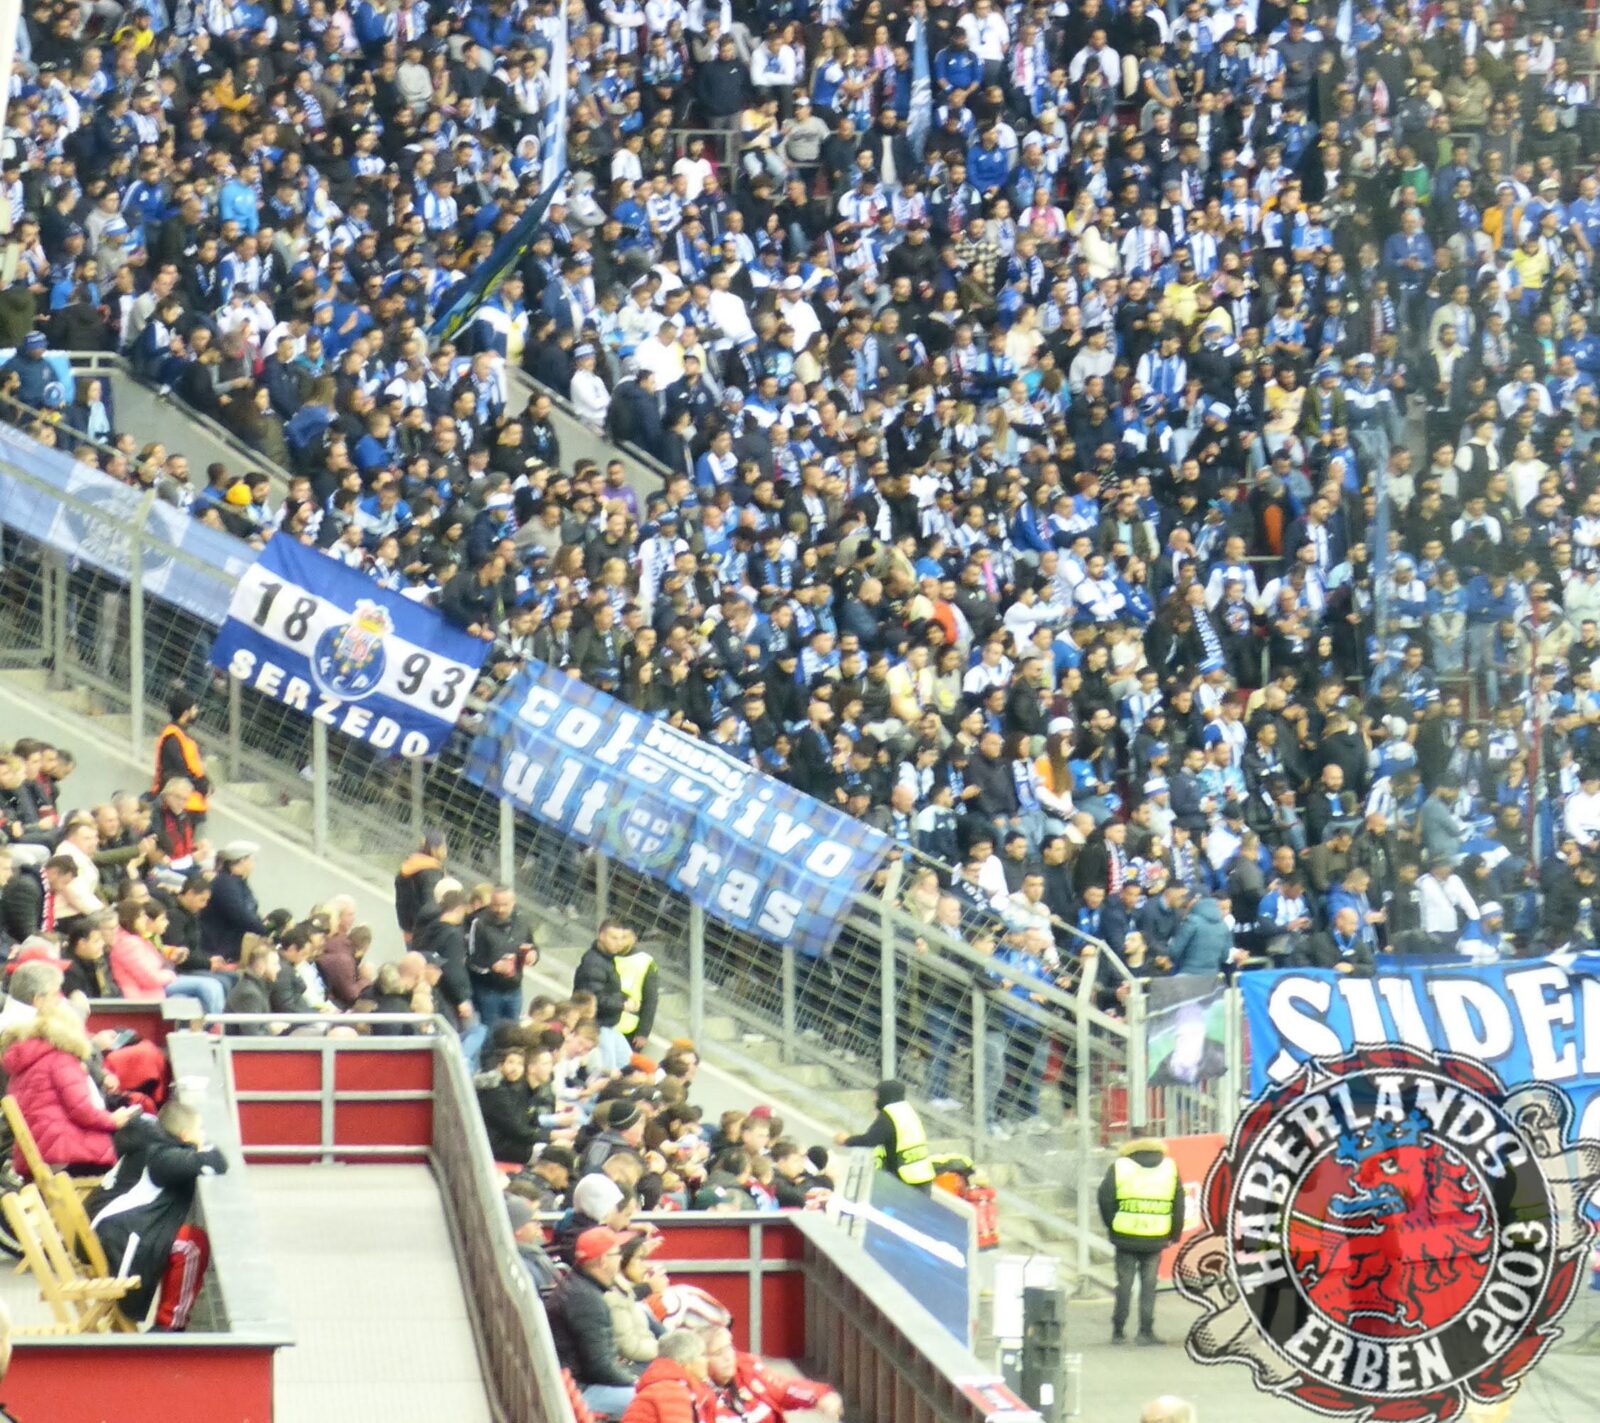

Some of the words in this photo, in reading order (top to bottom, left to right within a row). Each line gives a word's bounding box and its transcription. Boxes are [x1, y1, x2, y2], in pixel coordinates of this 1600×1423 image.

[229, 649, 430, 758] SERZEDO
[253, 582, 317, 641] 18
[397, 653, 465, 708] 93
